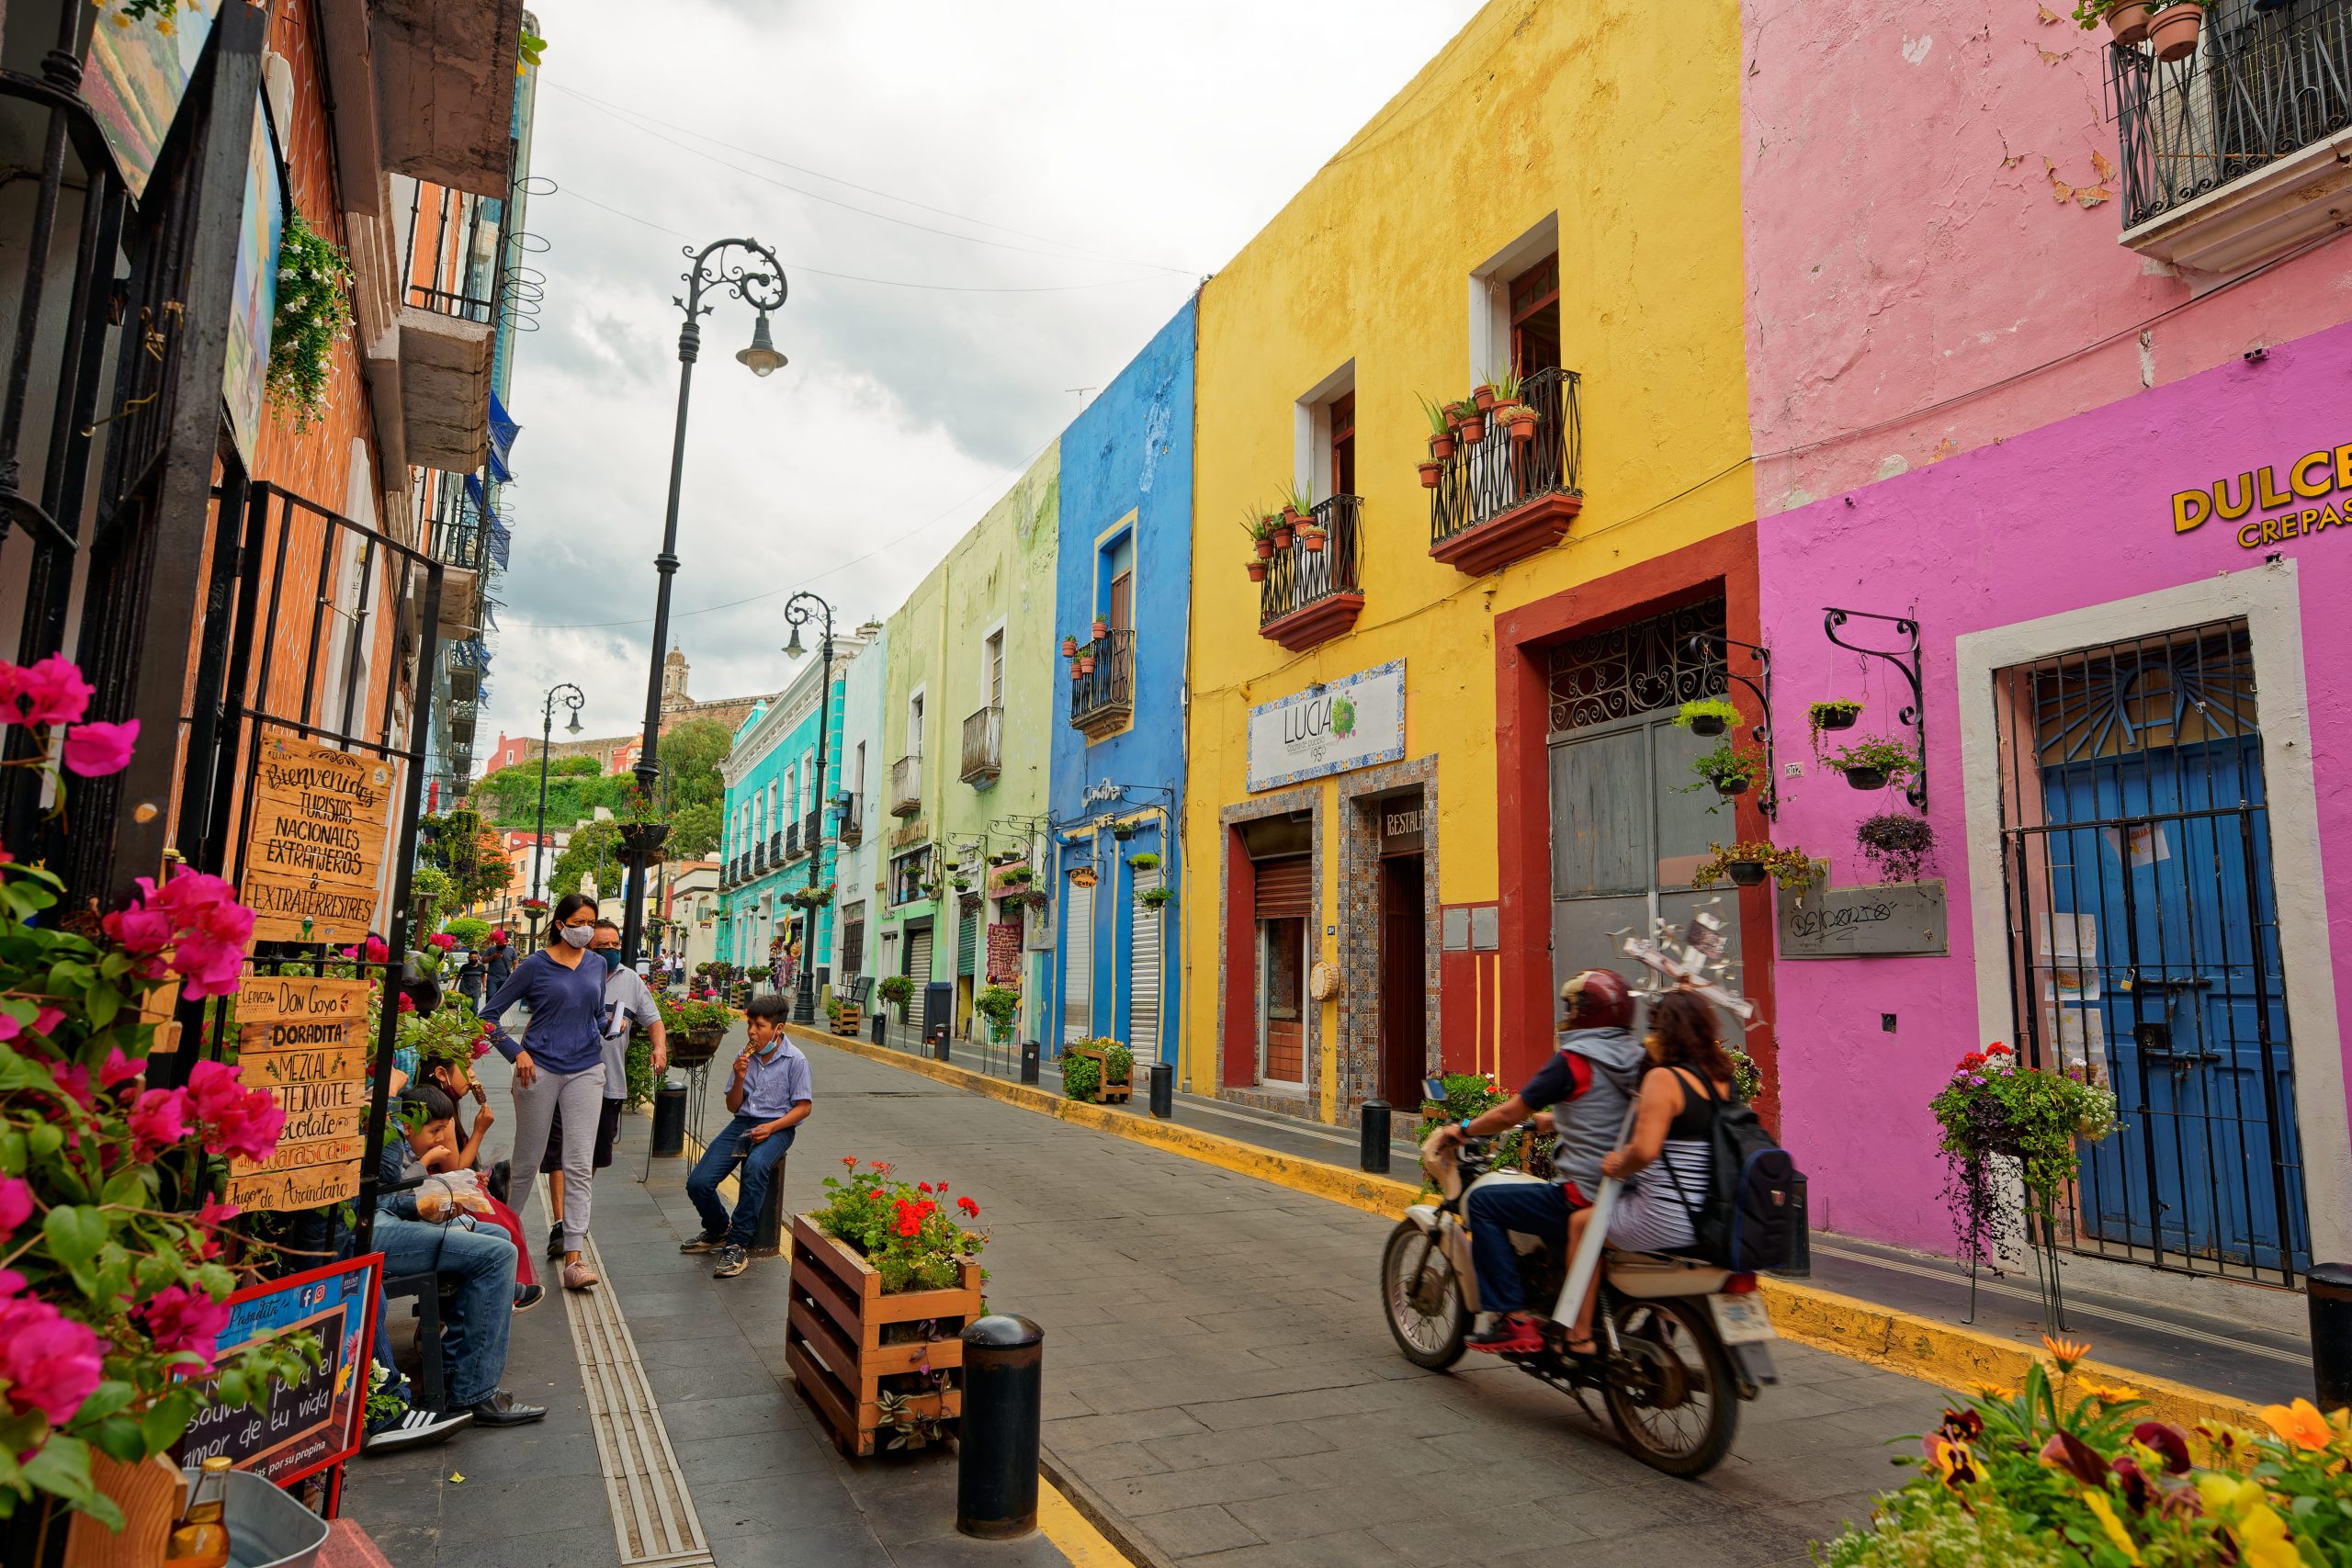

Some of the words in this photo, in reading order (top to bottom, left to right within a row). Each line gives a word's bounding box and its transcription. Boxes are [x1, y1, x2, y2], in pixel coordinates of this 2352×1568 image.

[1284, 695, 1332, 744] LUCIA
[266, 764, 375, 807] Bienvenidos
[275, 817, 360, 851] NACIONALES
[266, 839, 363, 875] EXTRANJEROS
[253, 884, 371, 922] EXTRATERRESTRES
[272, 1024, 342, 1046] DORADITA
[279, 1052, 327, 1082] MEZCAL
[280, 1082, 354, 1111] TEJOCOTE
[260, 1188, 275, 1209] de
[319, 1351, 333, 1376] el
[239, 1420, 262, 1449] de
[271, 1411, 289, 1431] tu
[299, 1388, 330, 1419] vida
[268, 1459, 285, 1475] por
[284, 1454, 295, 1466] su
[294, 1440, 326, 1464] propina
